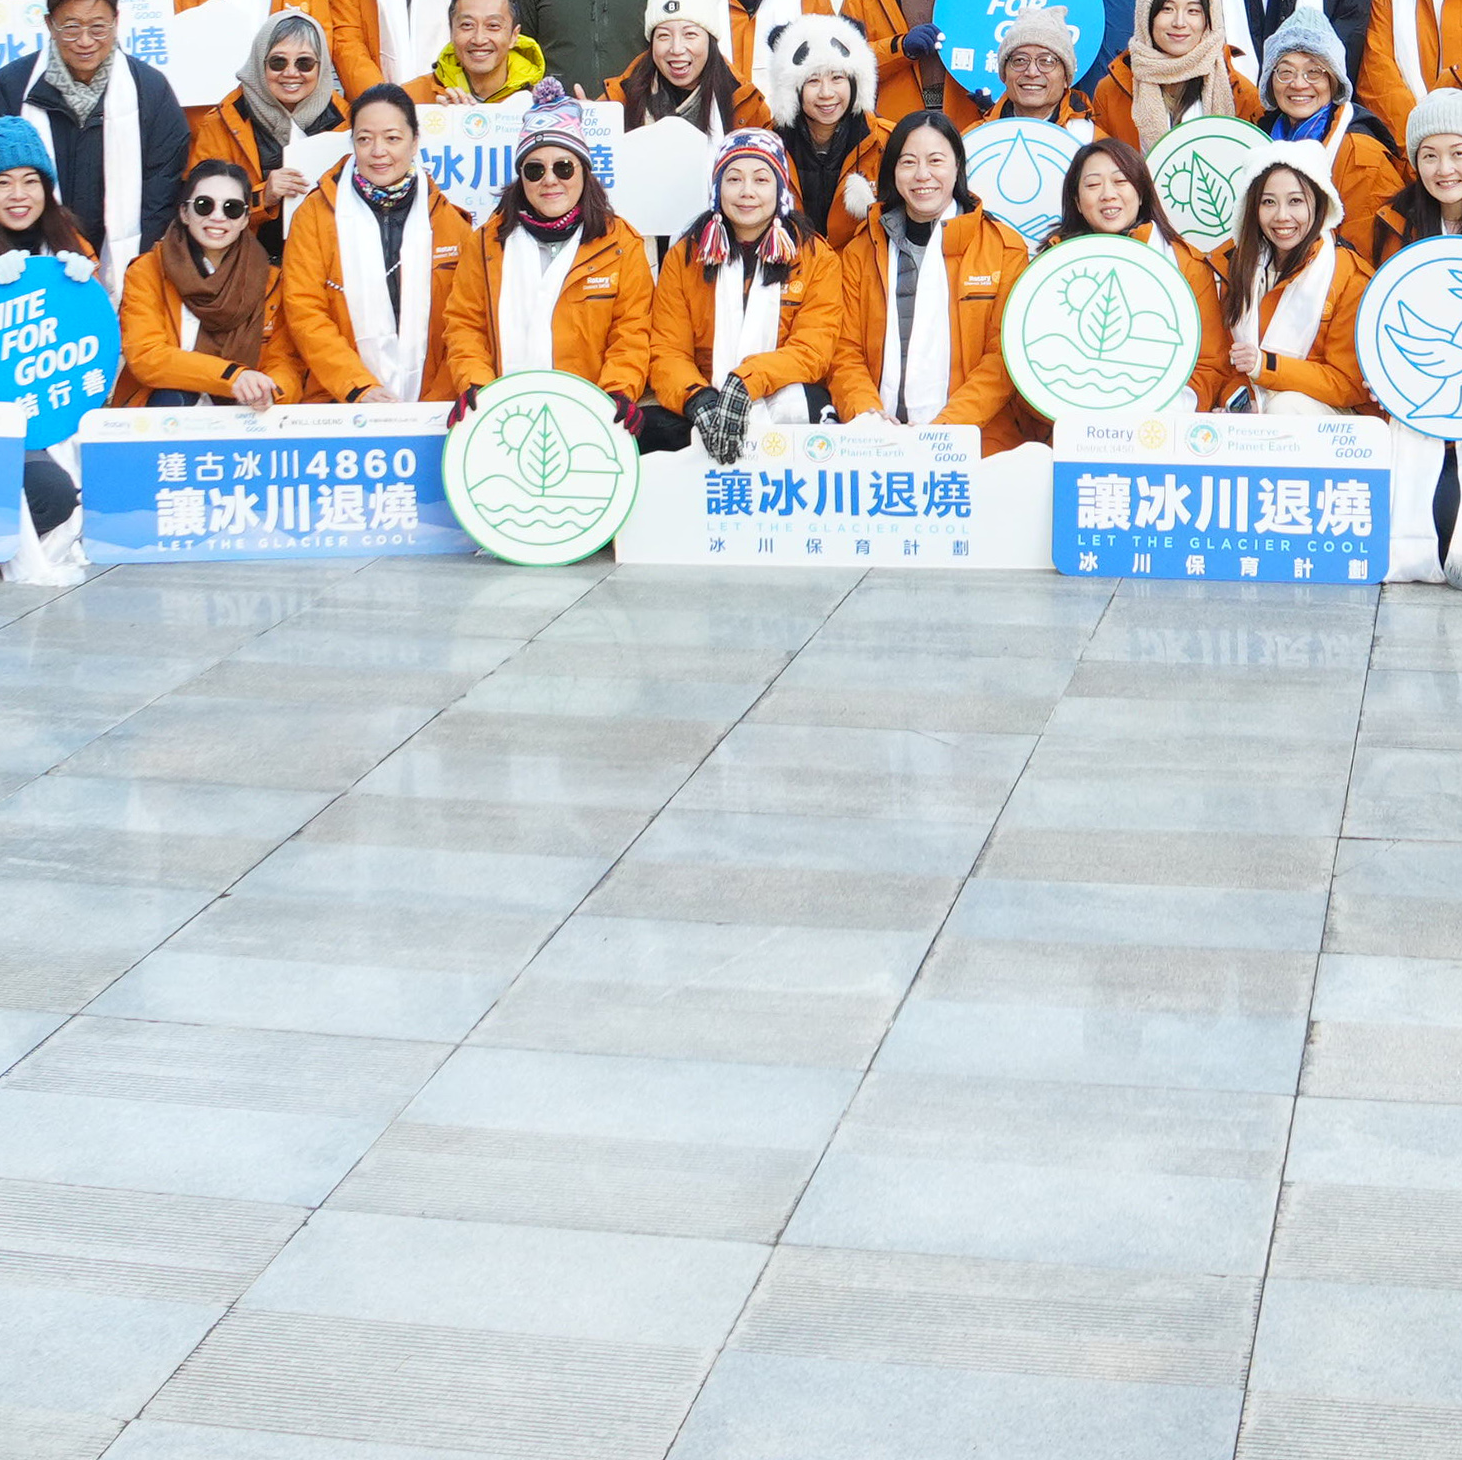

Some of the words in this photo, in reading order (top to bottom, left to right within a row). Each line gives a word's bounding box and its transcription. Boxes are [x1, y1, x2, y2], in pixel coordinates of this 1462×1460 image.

[132, 3, 149, 11] FOR
[135, 11, 162, 20] GOOD
[0, 317, 59, 361] FOR
[14, 335, 99, 387] GOOD
[1087, 426, 1133, 442] Rotary
[1228, 425, 1279, 436] Preserve
[1317, 423, 1354, 434] UNITE
[840, 435, 885, 444] Preserve
[919, 432, 950, 441] UNITE
[1332, 435, 1357, 446] FOR
[931, 443, 953, 451] FOR
[1228, 441, 1263, 452] Planet
[1268, 441, 1300, 452] Earth
[840, 448, 872, 458] Planet
[875, 448, 905, 457] Earth
[935, 453, 967, 462] GOOD
[1335, 448, 1373, 459] GOOD
[157, 448, 417, 483] 達古冰川4860
[705, 469, 972, 518] 讓冰川退燒
[155, 483, 419, 538] 讓冰川退燒
[1077, 473, 1373, 537] 讓冰川退燒
[707, 521, 741, 531] LET
[757, 522, 794, 532] THE
[808, 523, 901, 535] GLACIER
[914, 524, 970, 535] COOL
[157, 539, 192, 553] LET
[206, 538, 241, 552] THE
[258, 535, 348, 549] GLACIER
[361, 533, 417, 546] COOL
[709, 537, 970, 556] 冰川保育計劃
[1077, 534, 1117, 547] LET
[1132, 536, 1173, 548] THE
[1190, 537, 1291, 552] GLACIER
[1308, 540, 1368, 554] COOL
[1079, 551, 1368, 580] 冰川保育計劃
